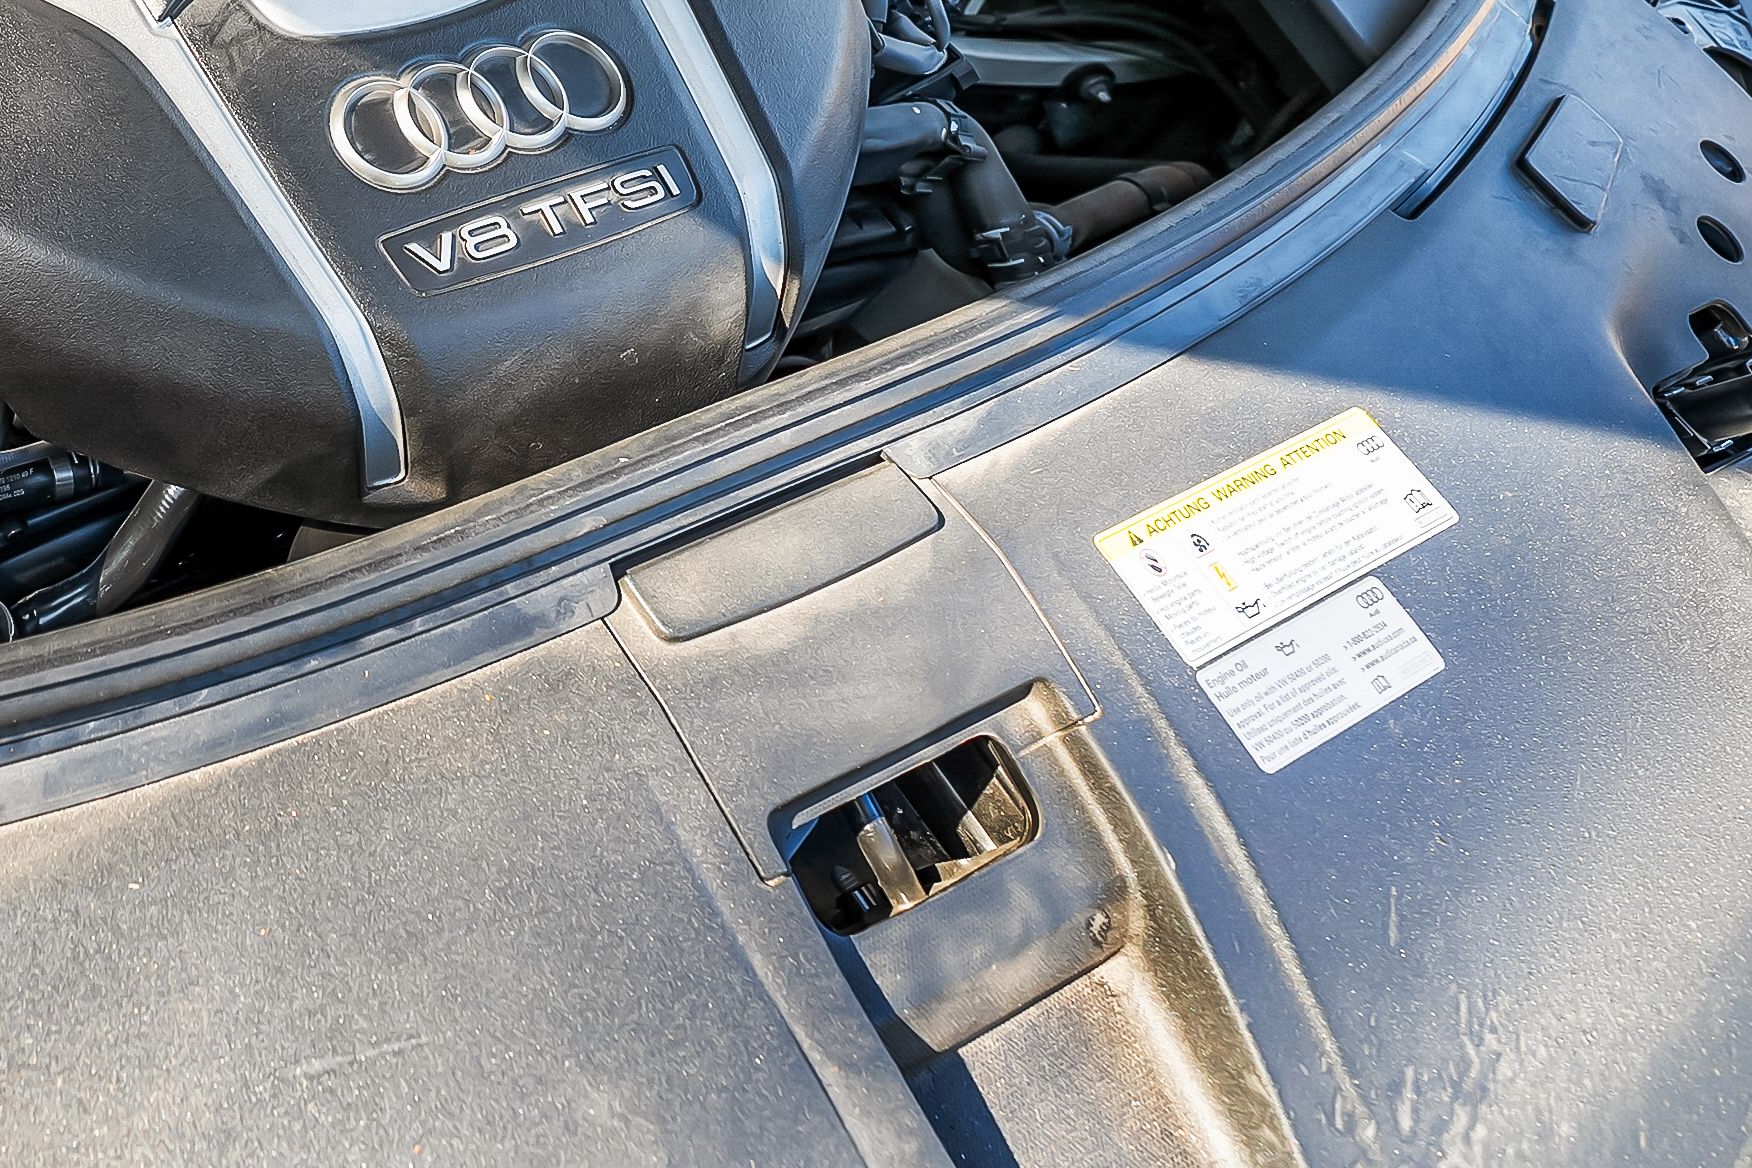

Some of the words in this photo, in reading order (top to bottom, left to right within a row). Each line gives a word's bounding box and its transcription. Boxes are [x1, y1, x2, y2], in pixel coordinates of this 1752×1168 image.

[403, 215, 520, 275] V8
[520, 164, 681, 238] TFSI
[1141, 495, 1212, 537] ACHTUNG
[1210, 462, 1278, 502] WARNING
[1275, 427, 1348, 469] ATTENTION
[1204, 666, 1238, 691] Engine
[1233, 659, 1249, 672] Oil
[1213, 682, 1239, 702] Huile
[1236, 666, 1271, 689] moteur
